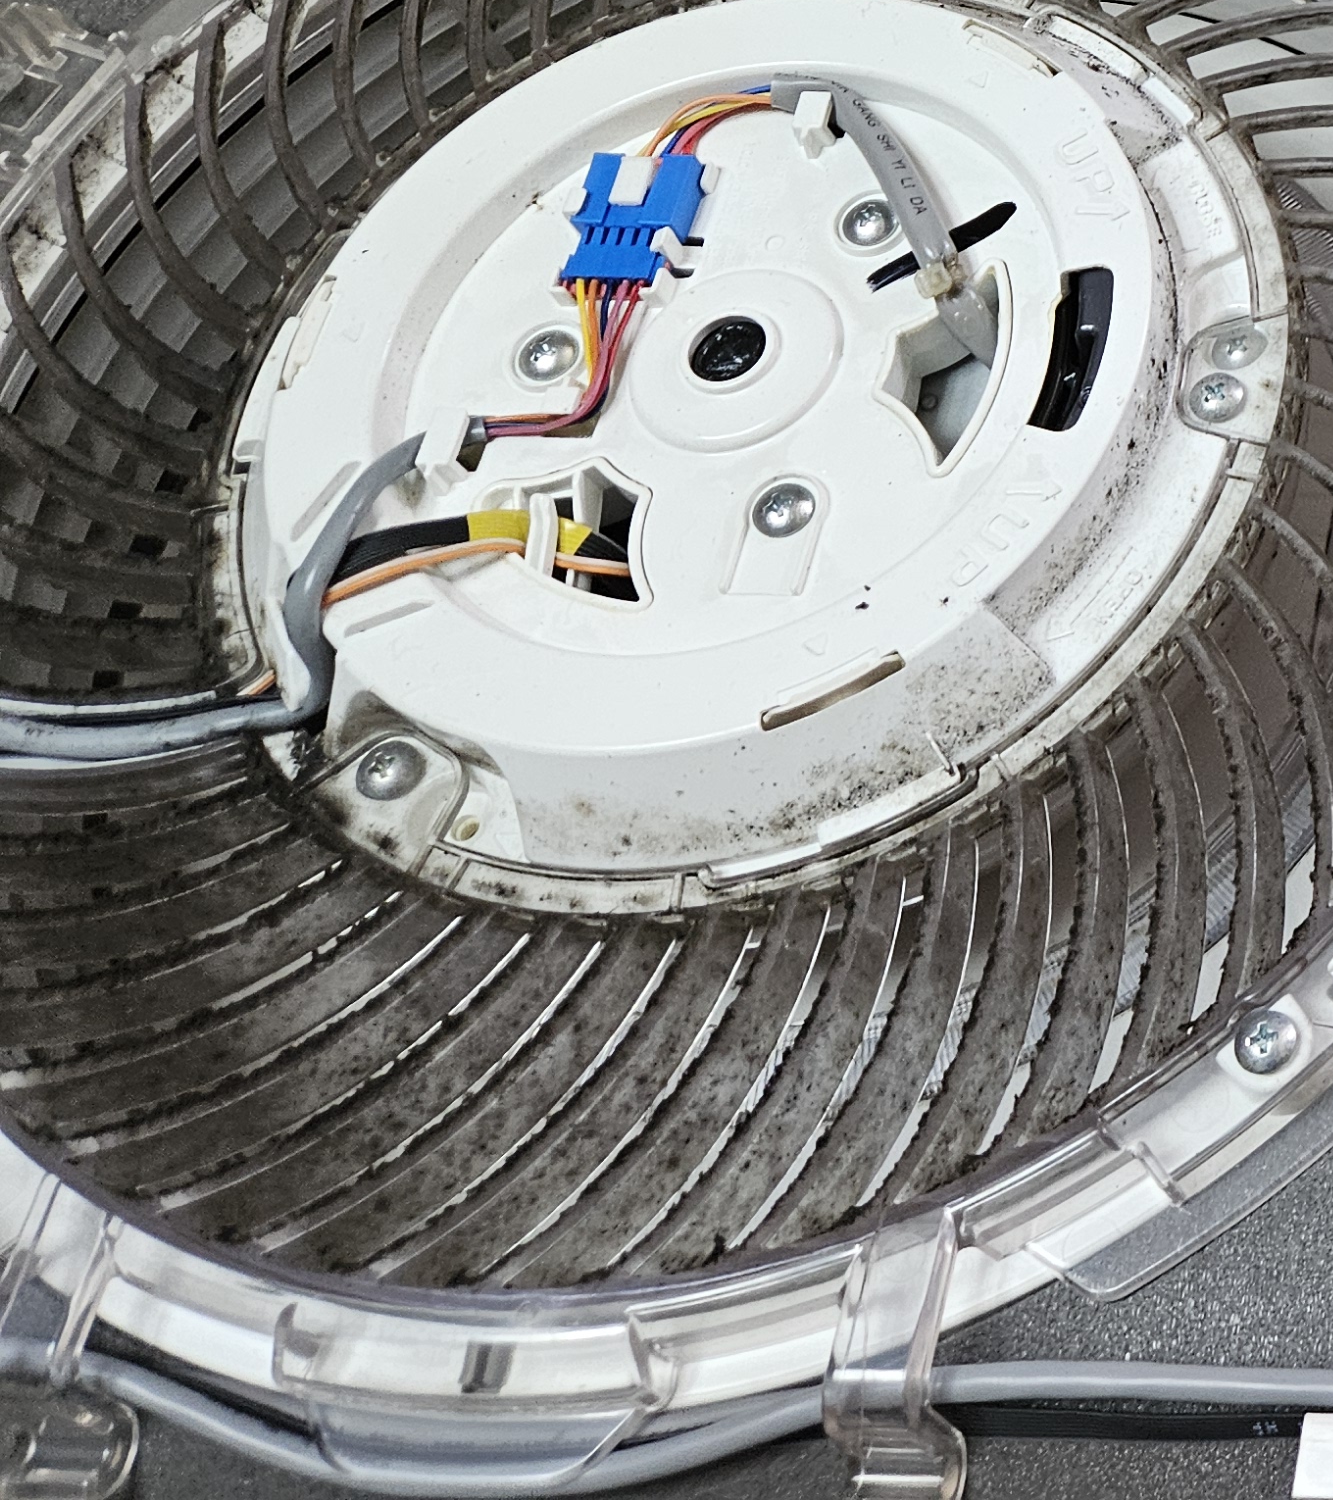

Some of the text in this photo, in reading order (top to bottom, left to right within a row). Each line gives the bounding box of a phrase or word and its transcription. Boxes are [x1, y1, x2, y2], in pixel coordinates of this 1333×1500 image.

[1055, 126, 1116, 194] UP
[900, 177, 916, 190] LI
[909, 196, 928, 216] DA
[950, 506, 1031, 587] UP
